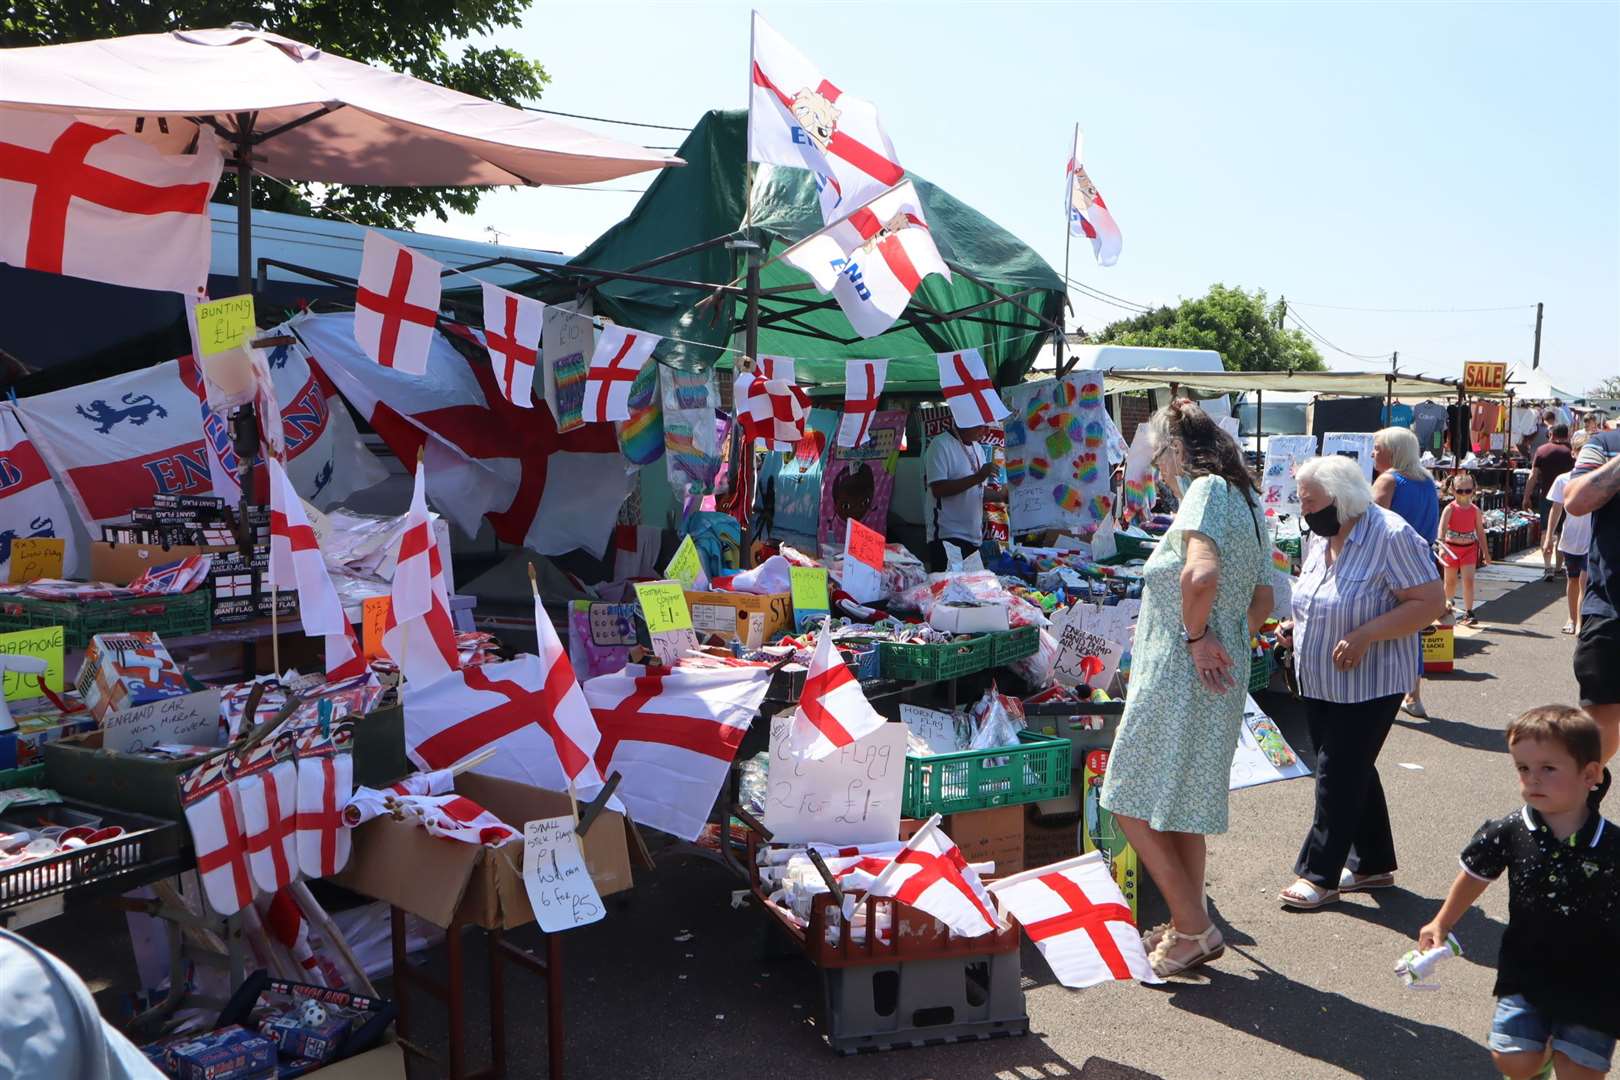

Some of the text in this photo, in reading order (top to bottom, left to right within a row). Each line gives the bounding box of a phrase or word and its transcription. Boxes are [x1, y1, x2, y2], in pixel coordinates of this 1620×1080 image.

[200, 299, 251, 320] BUNTING
[1465, 365, 1502, 388] SALE
[214, 605, 253, 615] GIANT FLAG
[279, 600, 296, 608] FLAG
[1059, 638, 1074, 650] AIR
[1062, 631, 1112, 655] HAND PUMP
[1064, 624, 1106, 647] ENGLAND
[160, 700, 185, 713] CAR
[771, 780, 796, 809] 2
[540, 891, 551, 907] 6
